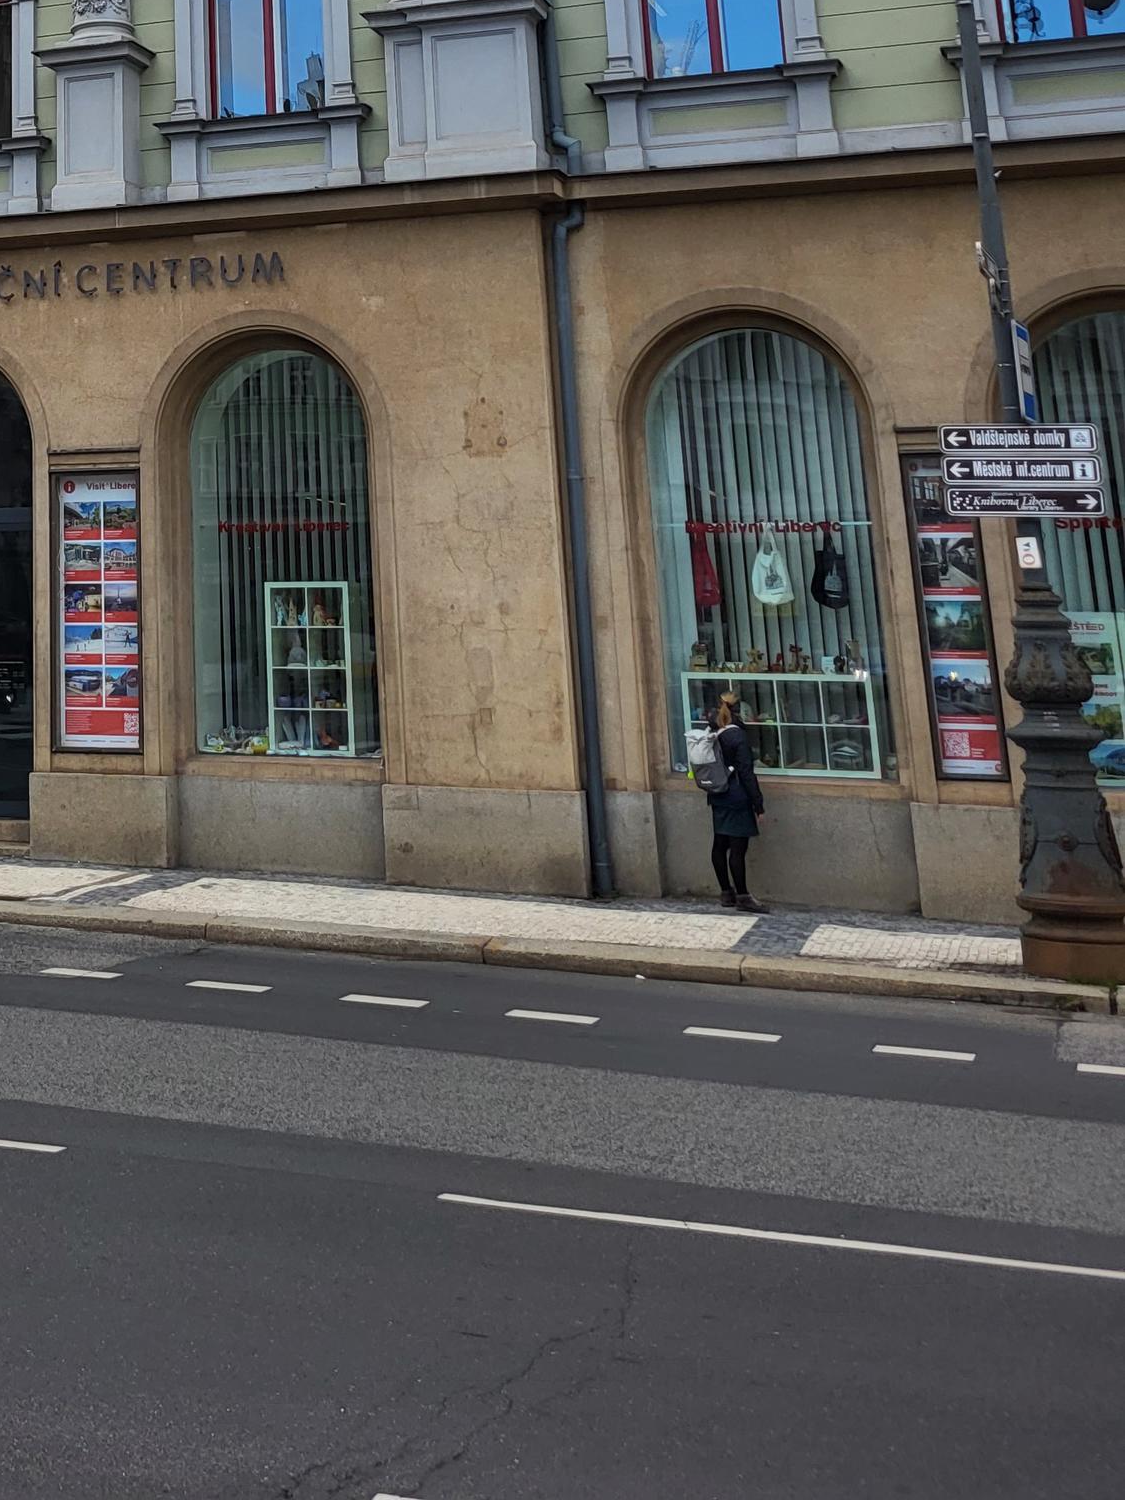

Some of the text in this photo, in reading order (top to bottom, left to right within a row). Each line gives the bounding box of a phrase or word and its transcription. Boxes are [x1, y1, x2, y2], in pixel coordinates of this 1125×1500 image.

[76, 251, 286, 299] CENTRUM
[969, 429, 1065, 448] Valdštejnské domky
[972, 460, 1013, 478] Městské
[86, 480, 136, 491] Visit Libere
[973, 495, 1057, 507] Knihovna Liberec
[775, 519, 843, 533] Liberec
